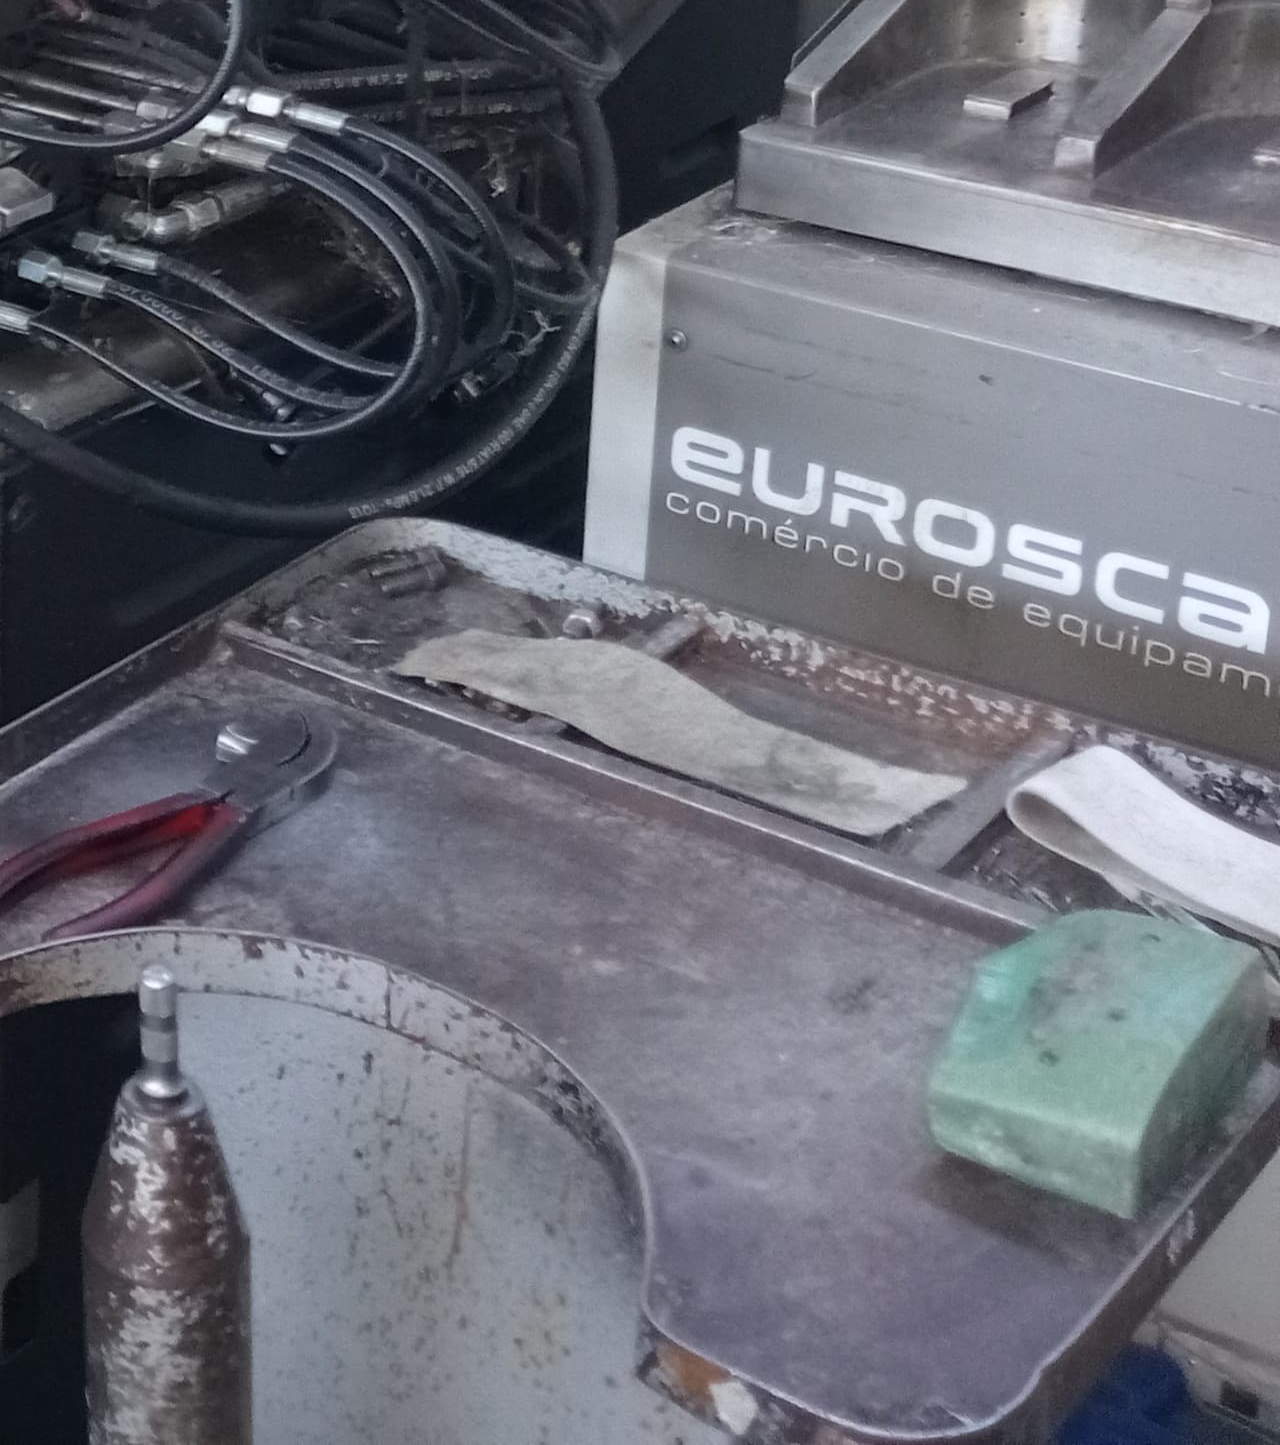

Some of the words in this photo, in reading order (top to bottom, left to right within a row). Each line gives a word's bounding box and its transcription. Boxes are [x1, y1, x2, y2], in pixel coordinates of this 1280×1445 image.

[665, 490, 906, 583] comércio
[931, 571, 996, 610] de
[1022, 599, 1280, 698] equipam
